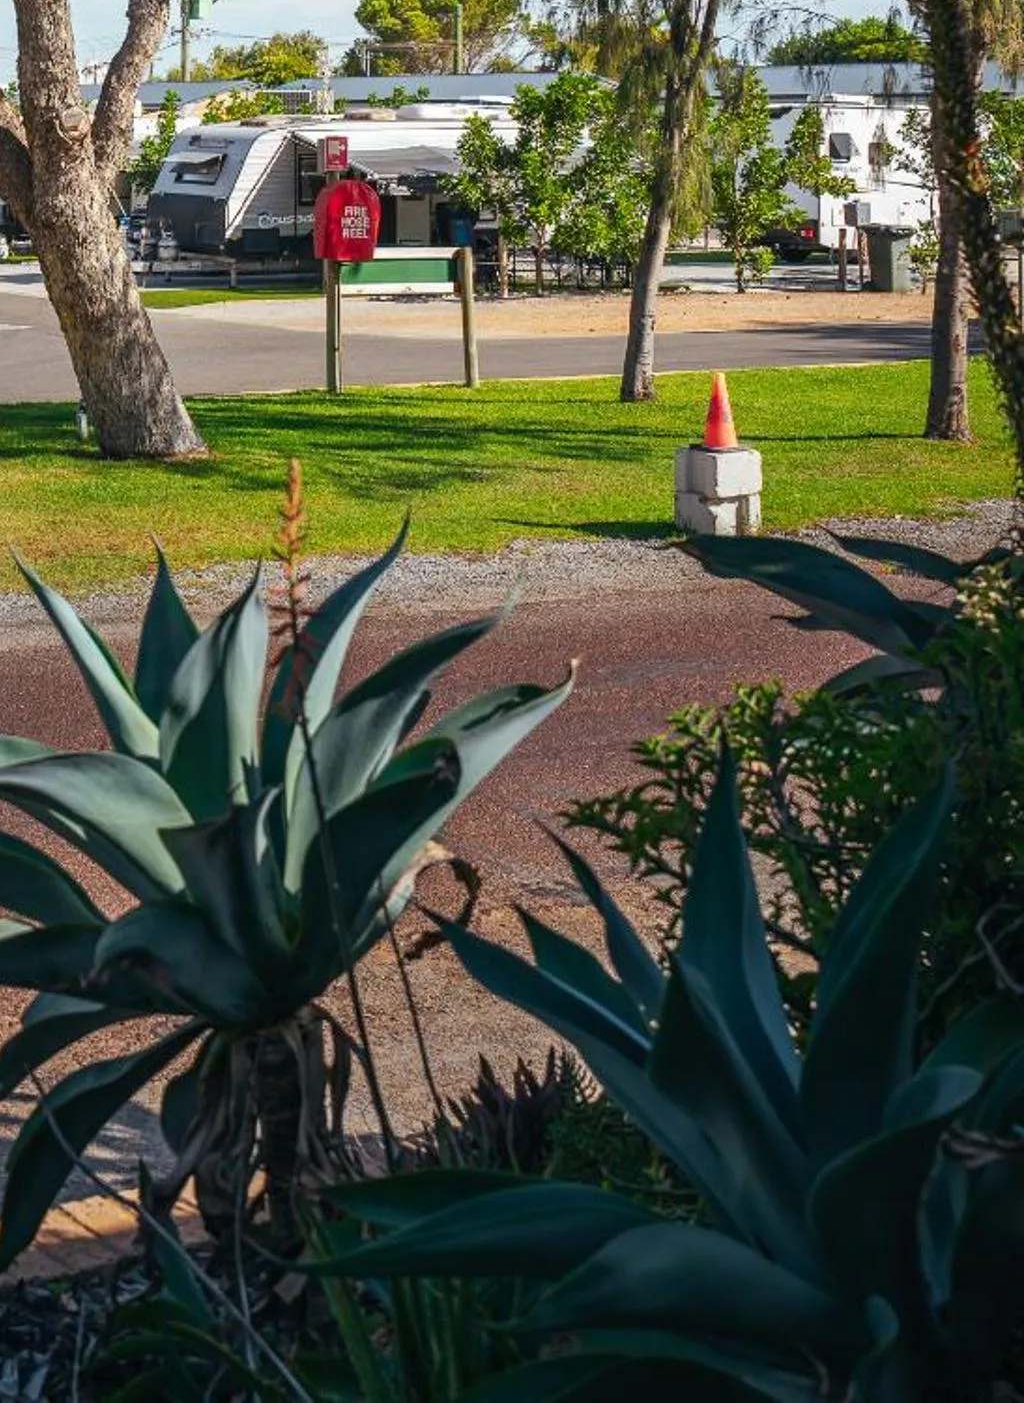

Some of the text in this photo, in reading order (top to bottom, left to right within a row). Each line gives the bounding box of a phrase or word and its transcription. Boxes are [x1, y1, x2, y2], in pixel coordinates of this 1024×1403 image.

[344, 205, 368, 217] FIRE
[341, 217, 370, 228] HOSE
[342, 228, 368, 239] REEL
